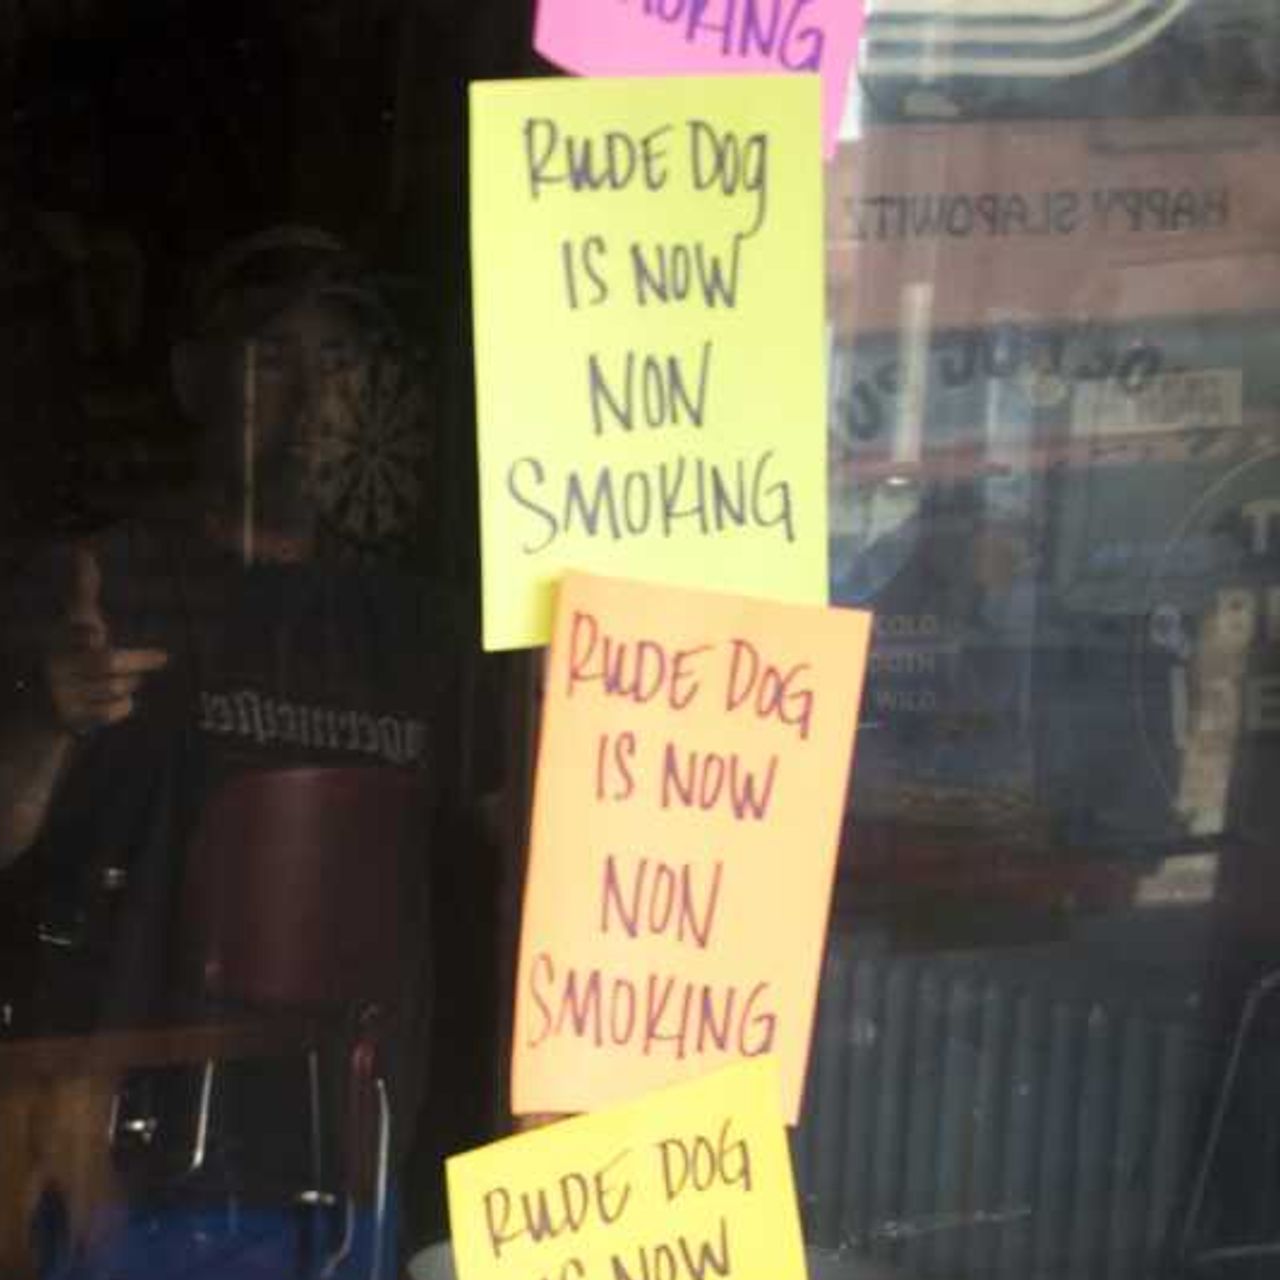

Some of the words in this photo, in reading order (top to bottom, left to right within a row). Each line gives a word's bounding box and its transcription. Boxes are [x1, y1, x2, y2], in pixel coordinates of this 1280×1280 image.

[523, 118, 676, 200] RUDE
[562, 234, 610, 310] IS
[638, 238, 744, 309] NOW
[588, 341, 713, 437] NON
[507, 449, 797, 555] SMOKING
[567, 611, 714, 711] RUDE
[725, 639, 814, 741] DOG
[595, 731, 637, 801] IS
[661, 741, 779, 821] NOW
[601, 854, 723, 949] NON
[527, 952, 778, 1060] SMOKING
[483, 1148, 635, 1258] RUDE
[659, 1116, 752, 1202] DOG
